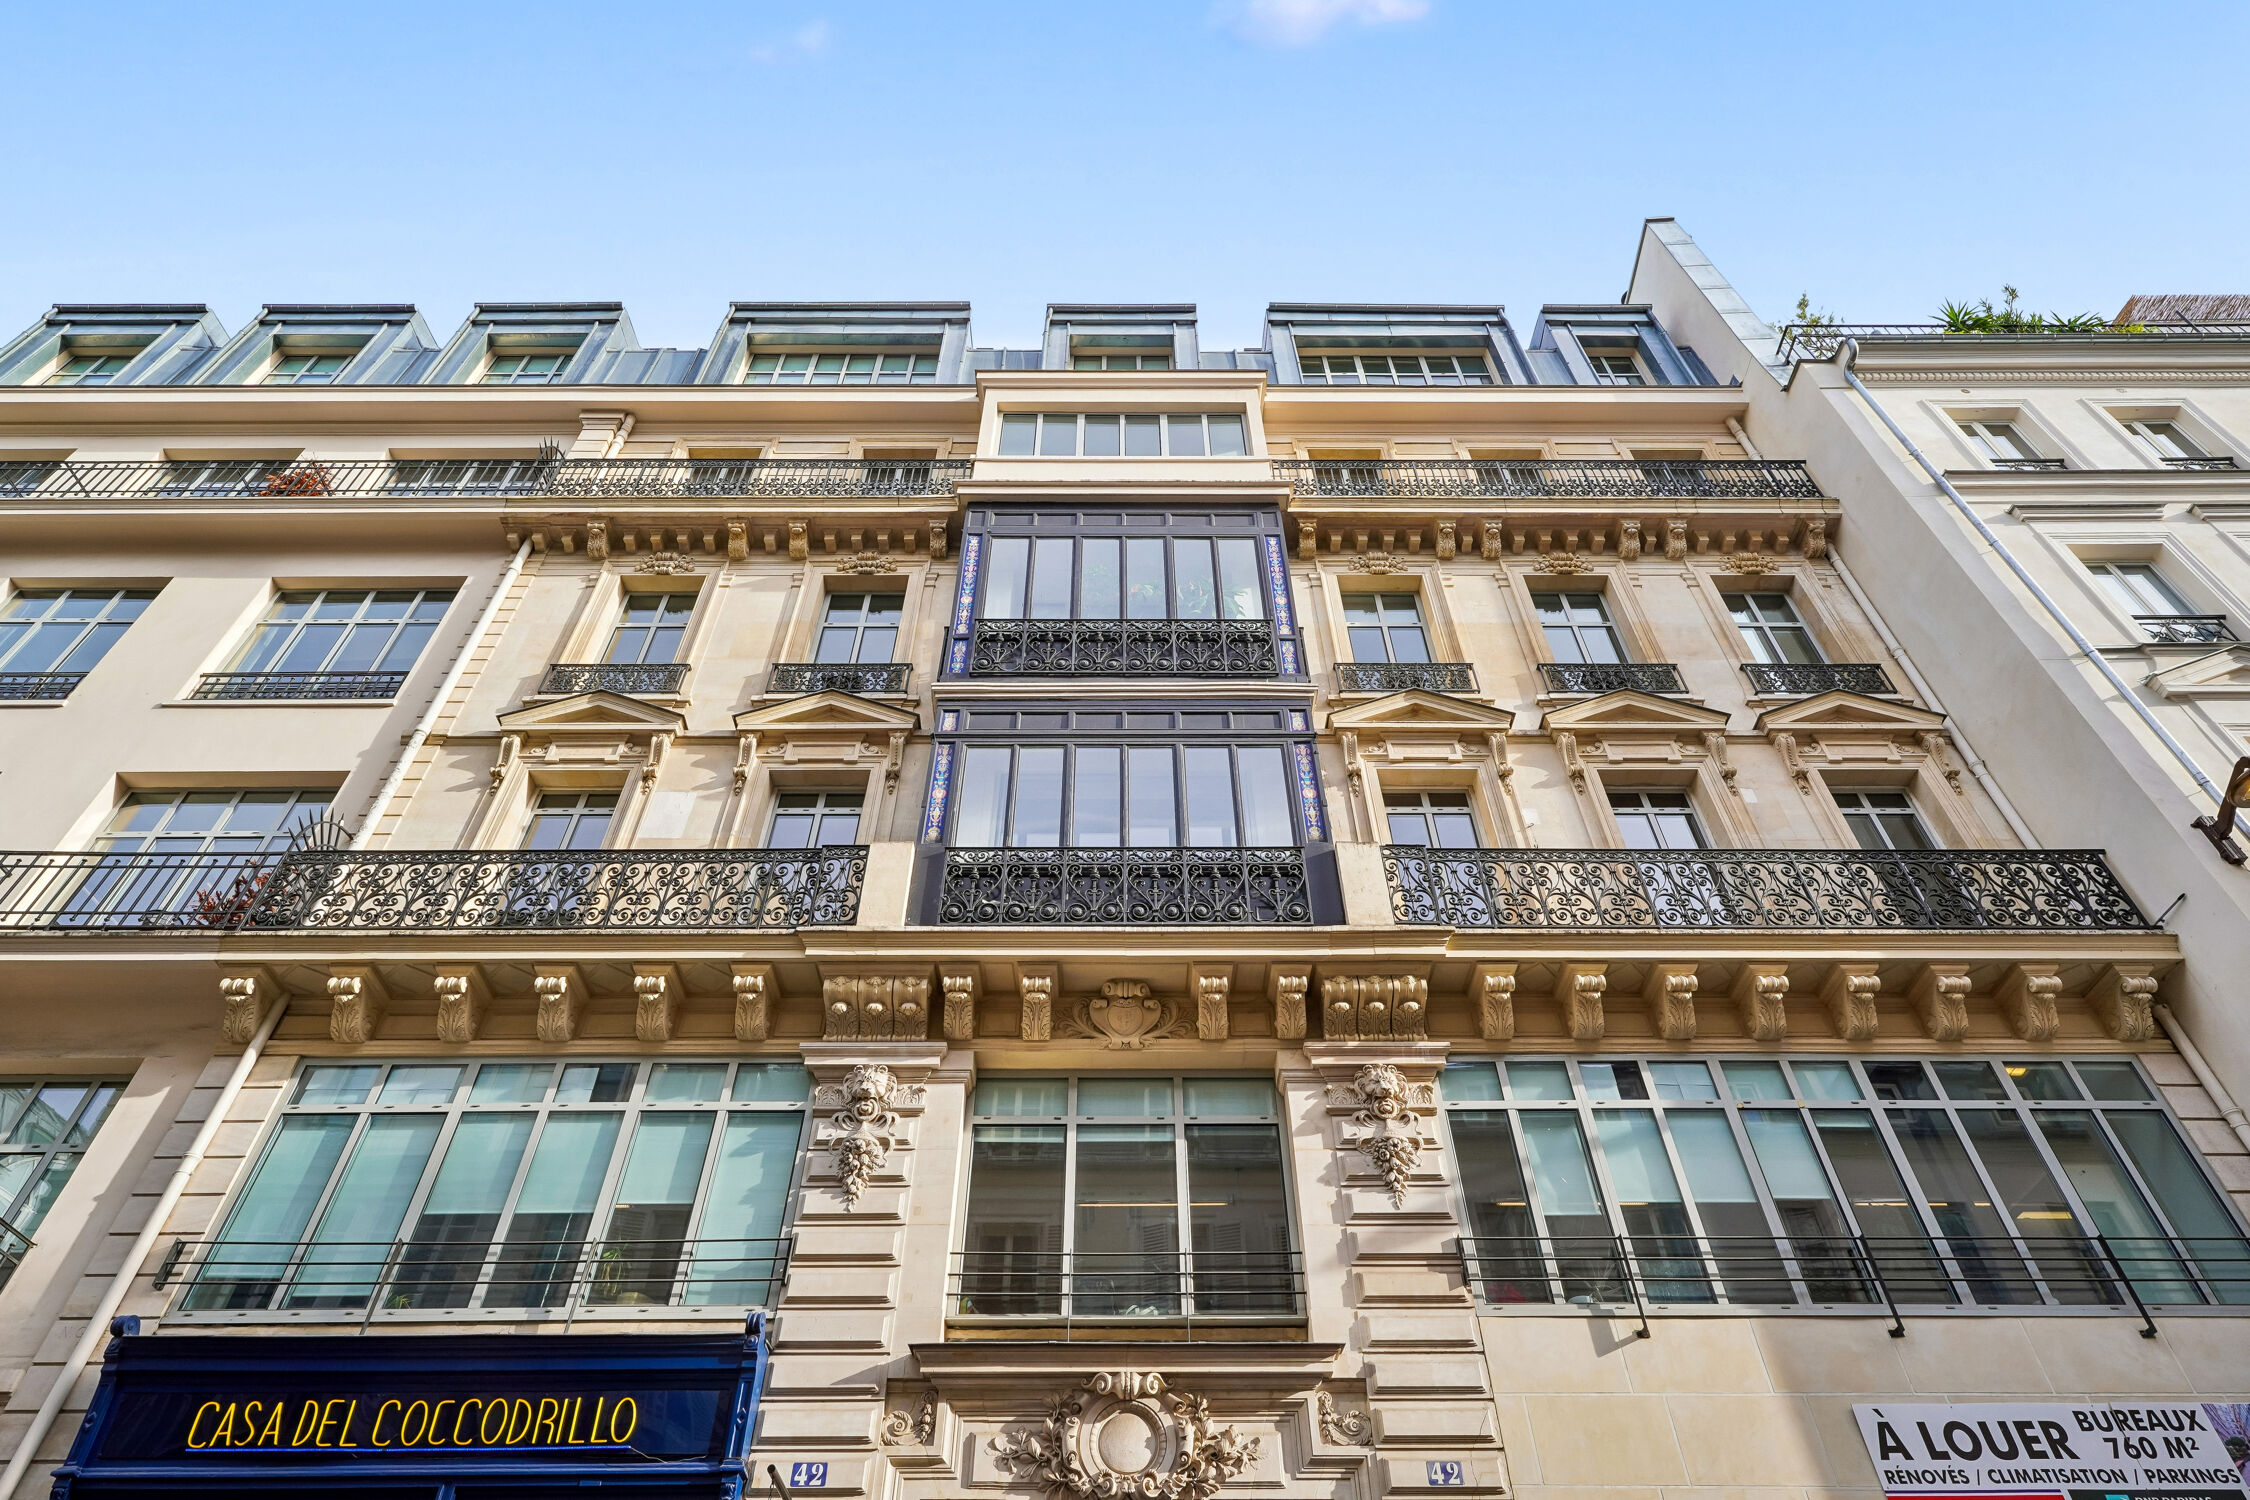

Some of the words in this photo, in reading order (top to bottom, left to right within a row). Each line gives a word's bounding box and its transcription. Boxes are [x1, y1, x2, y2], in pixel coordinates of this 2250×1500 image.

[187, 1401, 284, 1448] CASA
[291, 1399, 357, 1447] DEL
[372, 1397, 637, 1446] COCCODRILLO
[2072, 1409, 2208, 1432] BUREAUX
[1872, 1408, 1915, 1461] À
[1916, 1420, 2081, 1461] LOUER
[2102, 1437, 2158, 1459] 760
[794, 1463, 824, 1486] 42
[1431, 1462, 1461, 1485] 42
[1883, 1465, 1971, 1485] RÉNOVÉS
[1987, 1468, 2129, 1485] CLIMATISATION
[2143, 1468, 2242, 1484] PARKINGS
